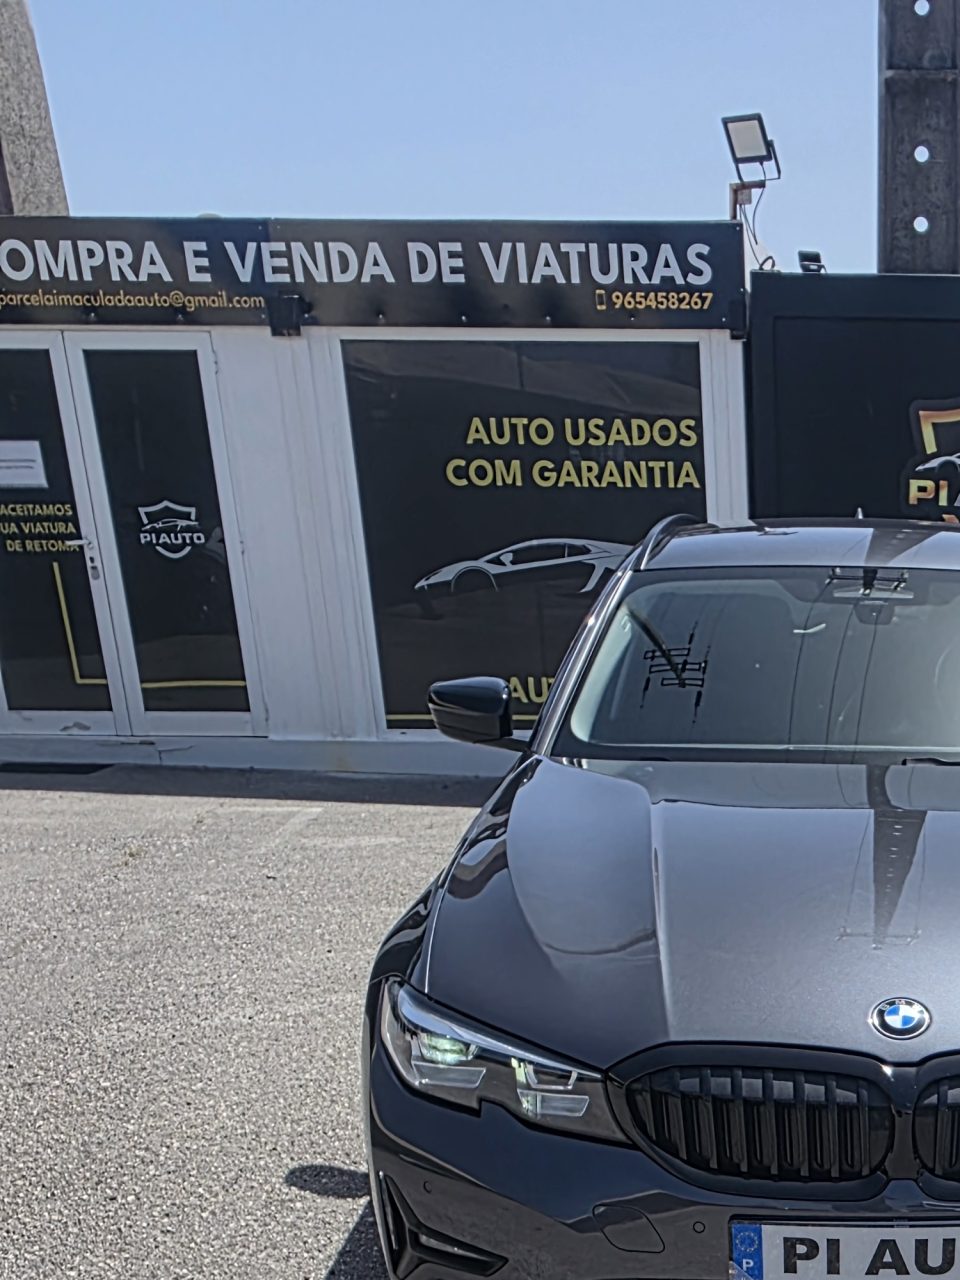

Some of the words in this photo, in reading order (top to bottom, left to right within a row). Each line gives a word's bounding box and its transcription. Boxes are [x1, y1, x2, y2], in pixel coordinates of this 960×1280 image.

[0, 238, 174, 283] OMPRA
[182, 241, 212, 282] E
[223, 241, 396, 284] VENDA
[406, 241, 466, 284] DE
[478, 242, 713, 286] VIATURAS
[611, 291, 713, 311] 965458267
[466, 416, 555, 446] AUTO
[564, 418, 698, 448] USADOS
[445, 458, 523, 487] COM
[531, 459, 701, 489] GARANTIA
[0, 504, 73, 516] ACEITAMOS
[22, 522, 76, 534] VIATURA
[6, 540, 25, 552] DE
[508, 676, 557, 704] AU
[742, 1258, 754, 1271] P
[782, 1236, 841, 1275] PI
